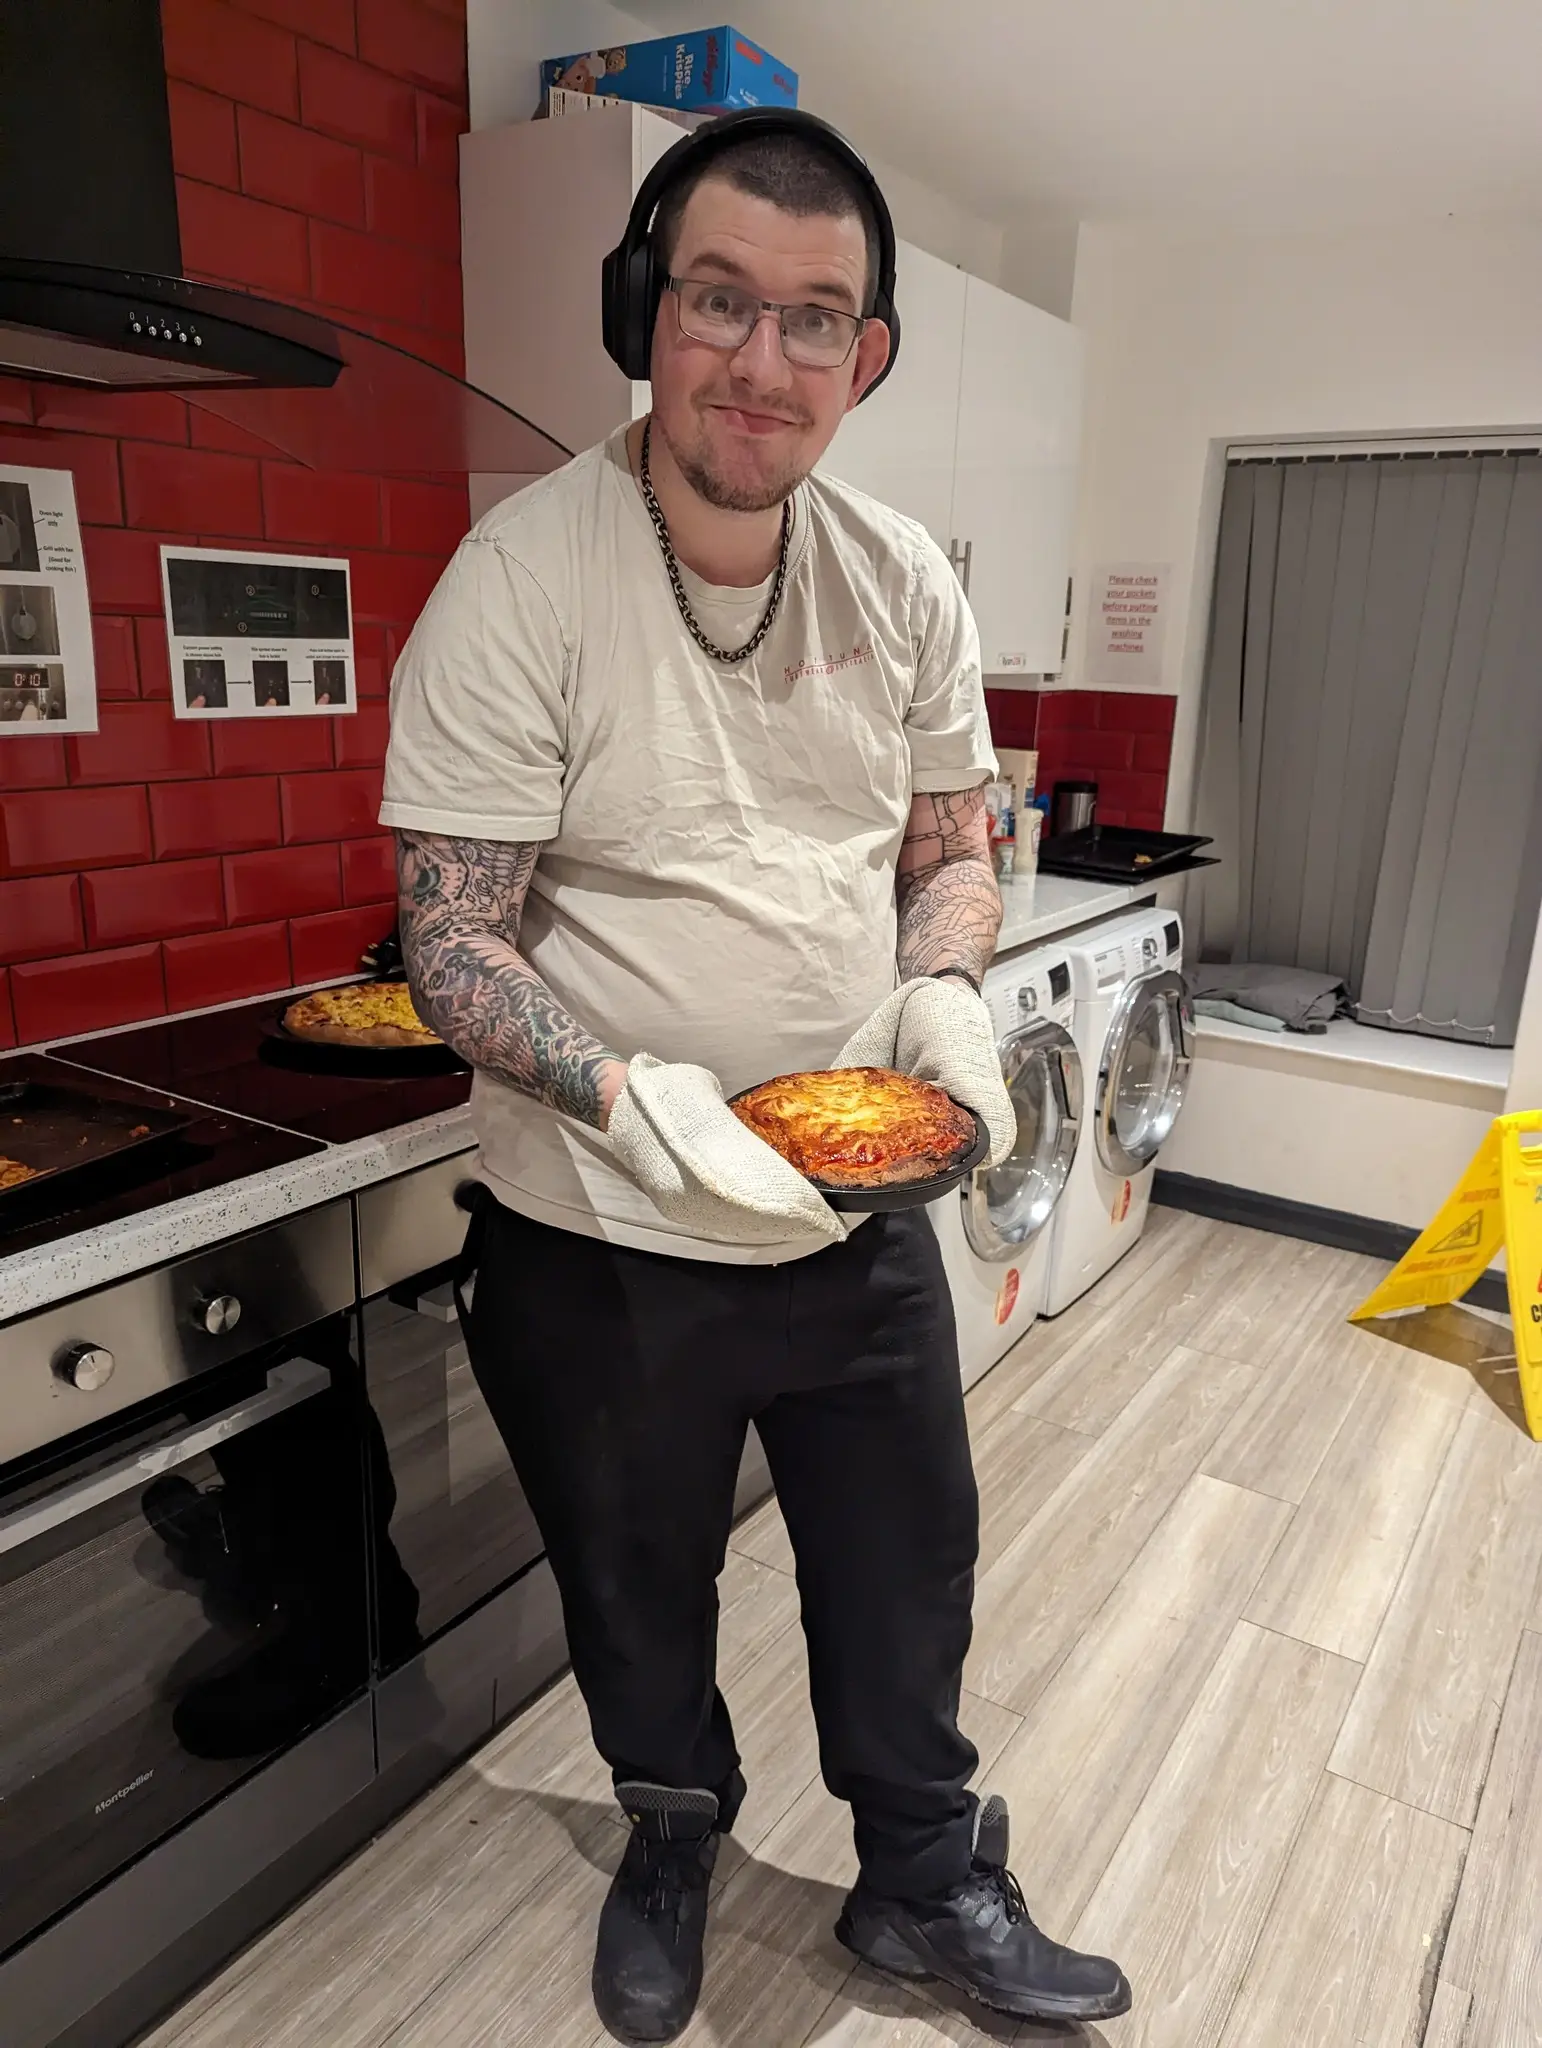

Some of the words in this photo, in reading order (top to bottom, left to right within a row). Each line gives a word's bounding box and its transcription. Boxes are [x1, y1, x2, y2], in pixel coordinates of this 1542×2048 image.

[674, 44, 686, 100] Krispies
[684, 53, 694, 85] Rice
[160, 318, 166, 328] 2
[175, 322, 181, 332] 3
[1108, 575, 1133, 585] Please
[1135, 575, 1158, 586] check
[1106, 590, 1125, 599] your
[1126, 589, 1156, 600] pockets
[1102, 601, 1128, 612] before
[1129, 603, 1158, 613] putting
[1106, 616, 1127, 626] items
[1129, 616, 1137, 626] in
[1138, 616, 1151, 627] the
[1111, 629, 1142, 640] washing
[1107, 642, 1144, 652] machines
[95, 1768, 154, 1815] Montpellier
